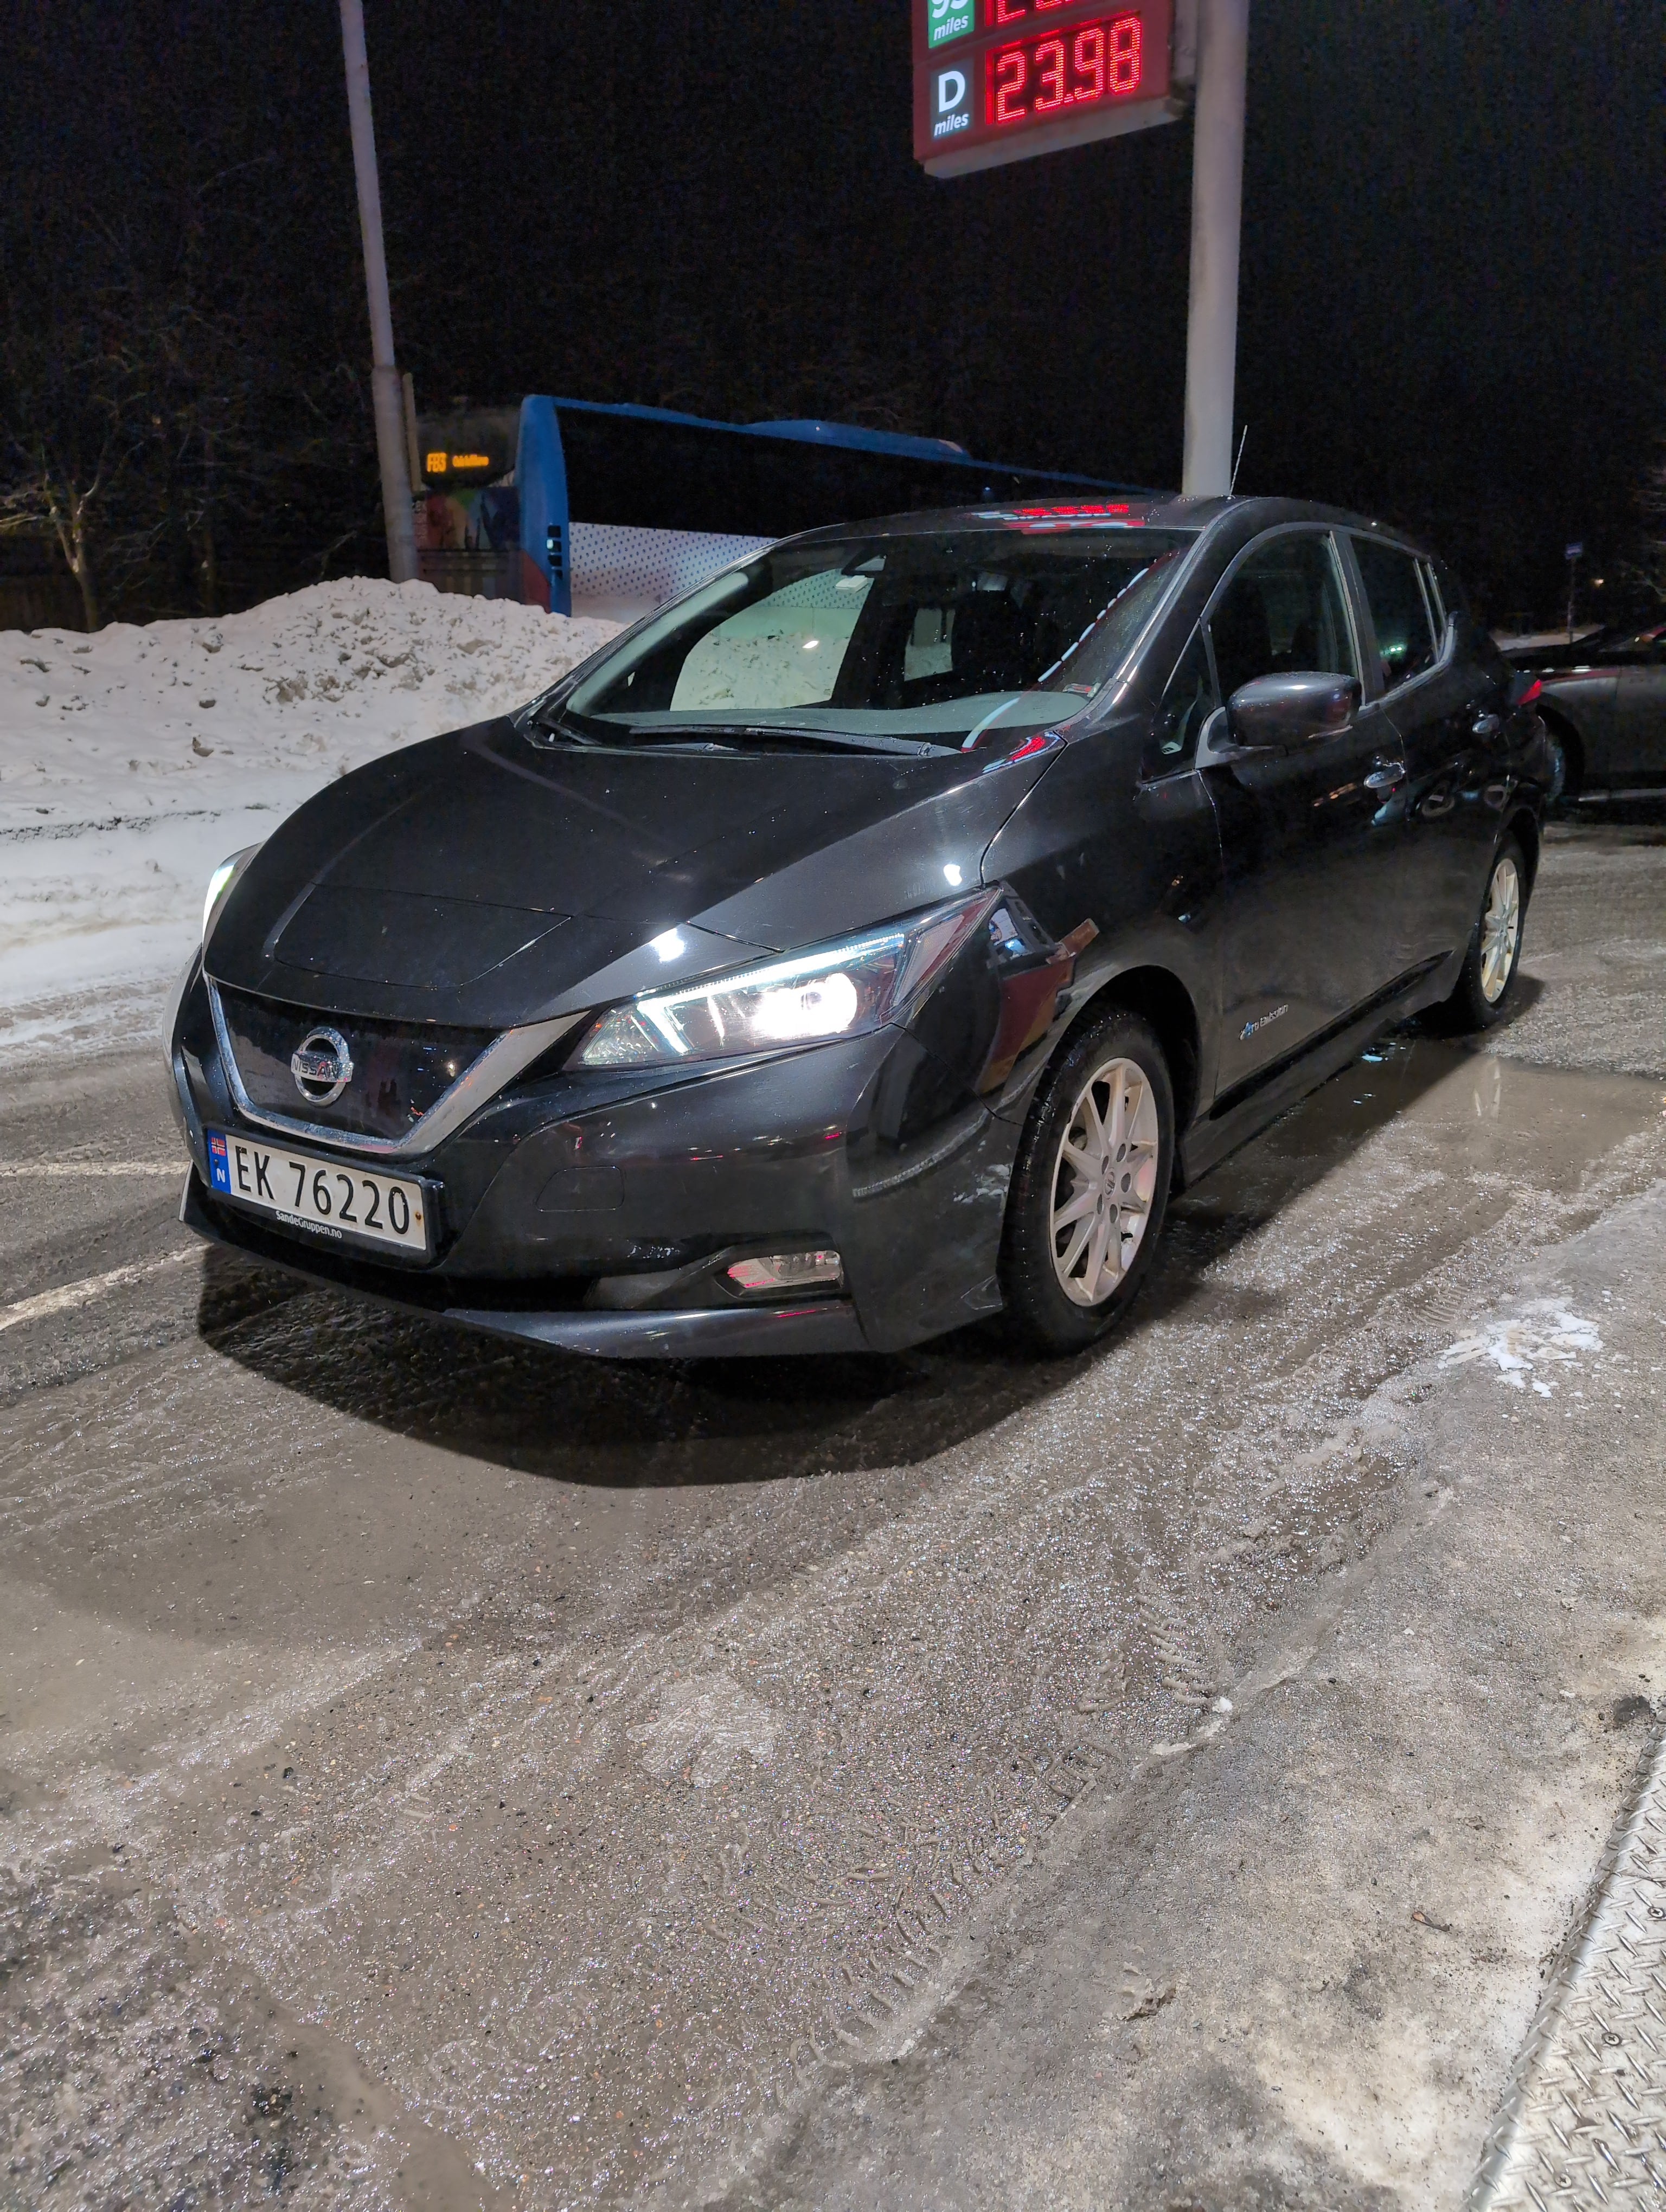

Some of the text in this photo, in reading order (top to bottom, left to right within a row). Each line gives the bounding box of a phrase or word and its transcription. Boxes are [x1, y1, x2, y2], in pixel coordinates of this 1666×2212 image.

[933, 15, 969, 41] miles
[997, 16, 1141, 124] 23.98
[938, 70, 966, 113] D
[934, 113, 969, 137] miles
[292, 1057, 339, 1079] NISSAN
[216, 1167, 226, 1183] N
[235, 1146, 409, 1234] EK 76220
[275, 1210, 343, 1239] SandeGruppen.no
